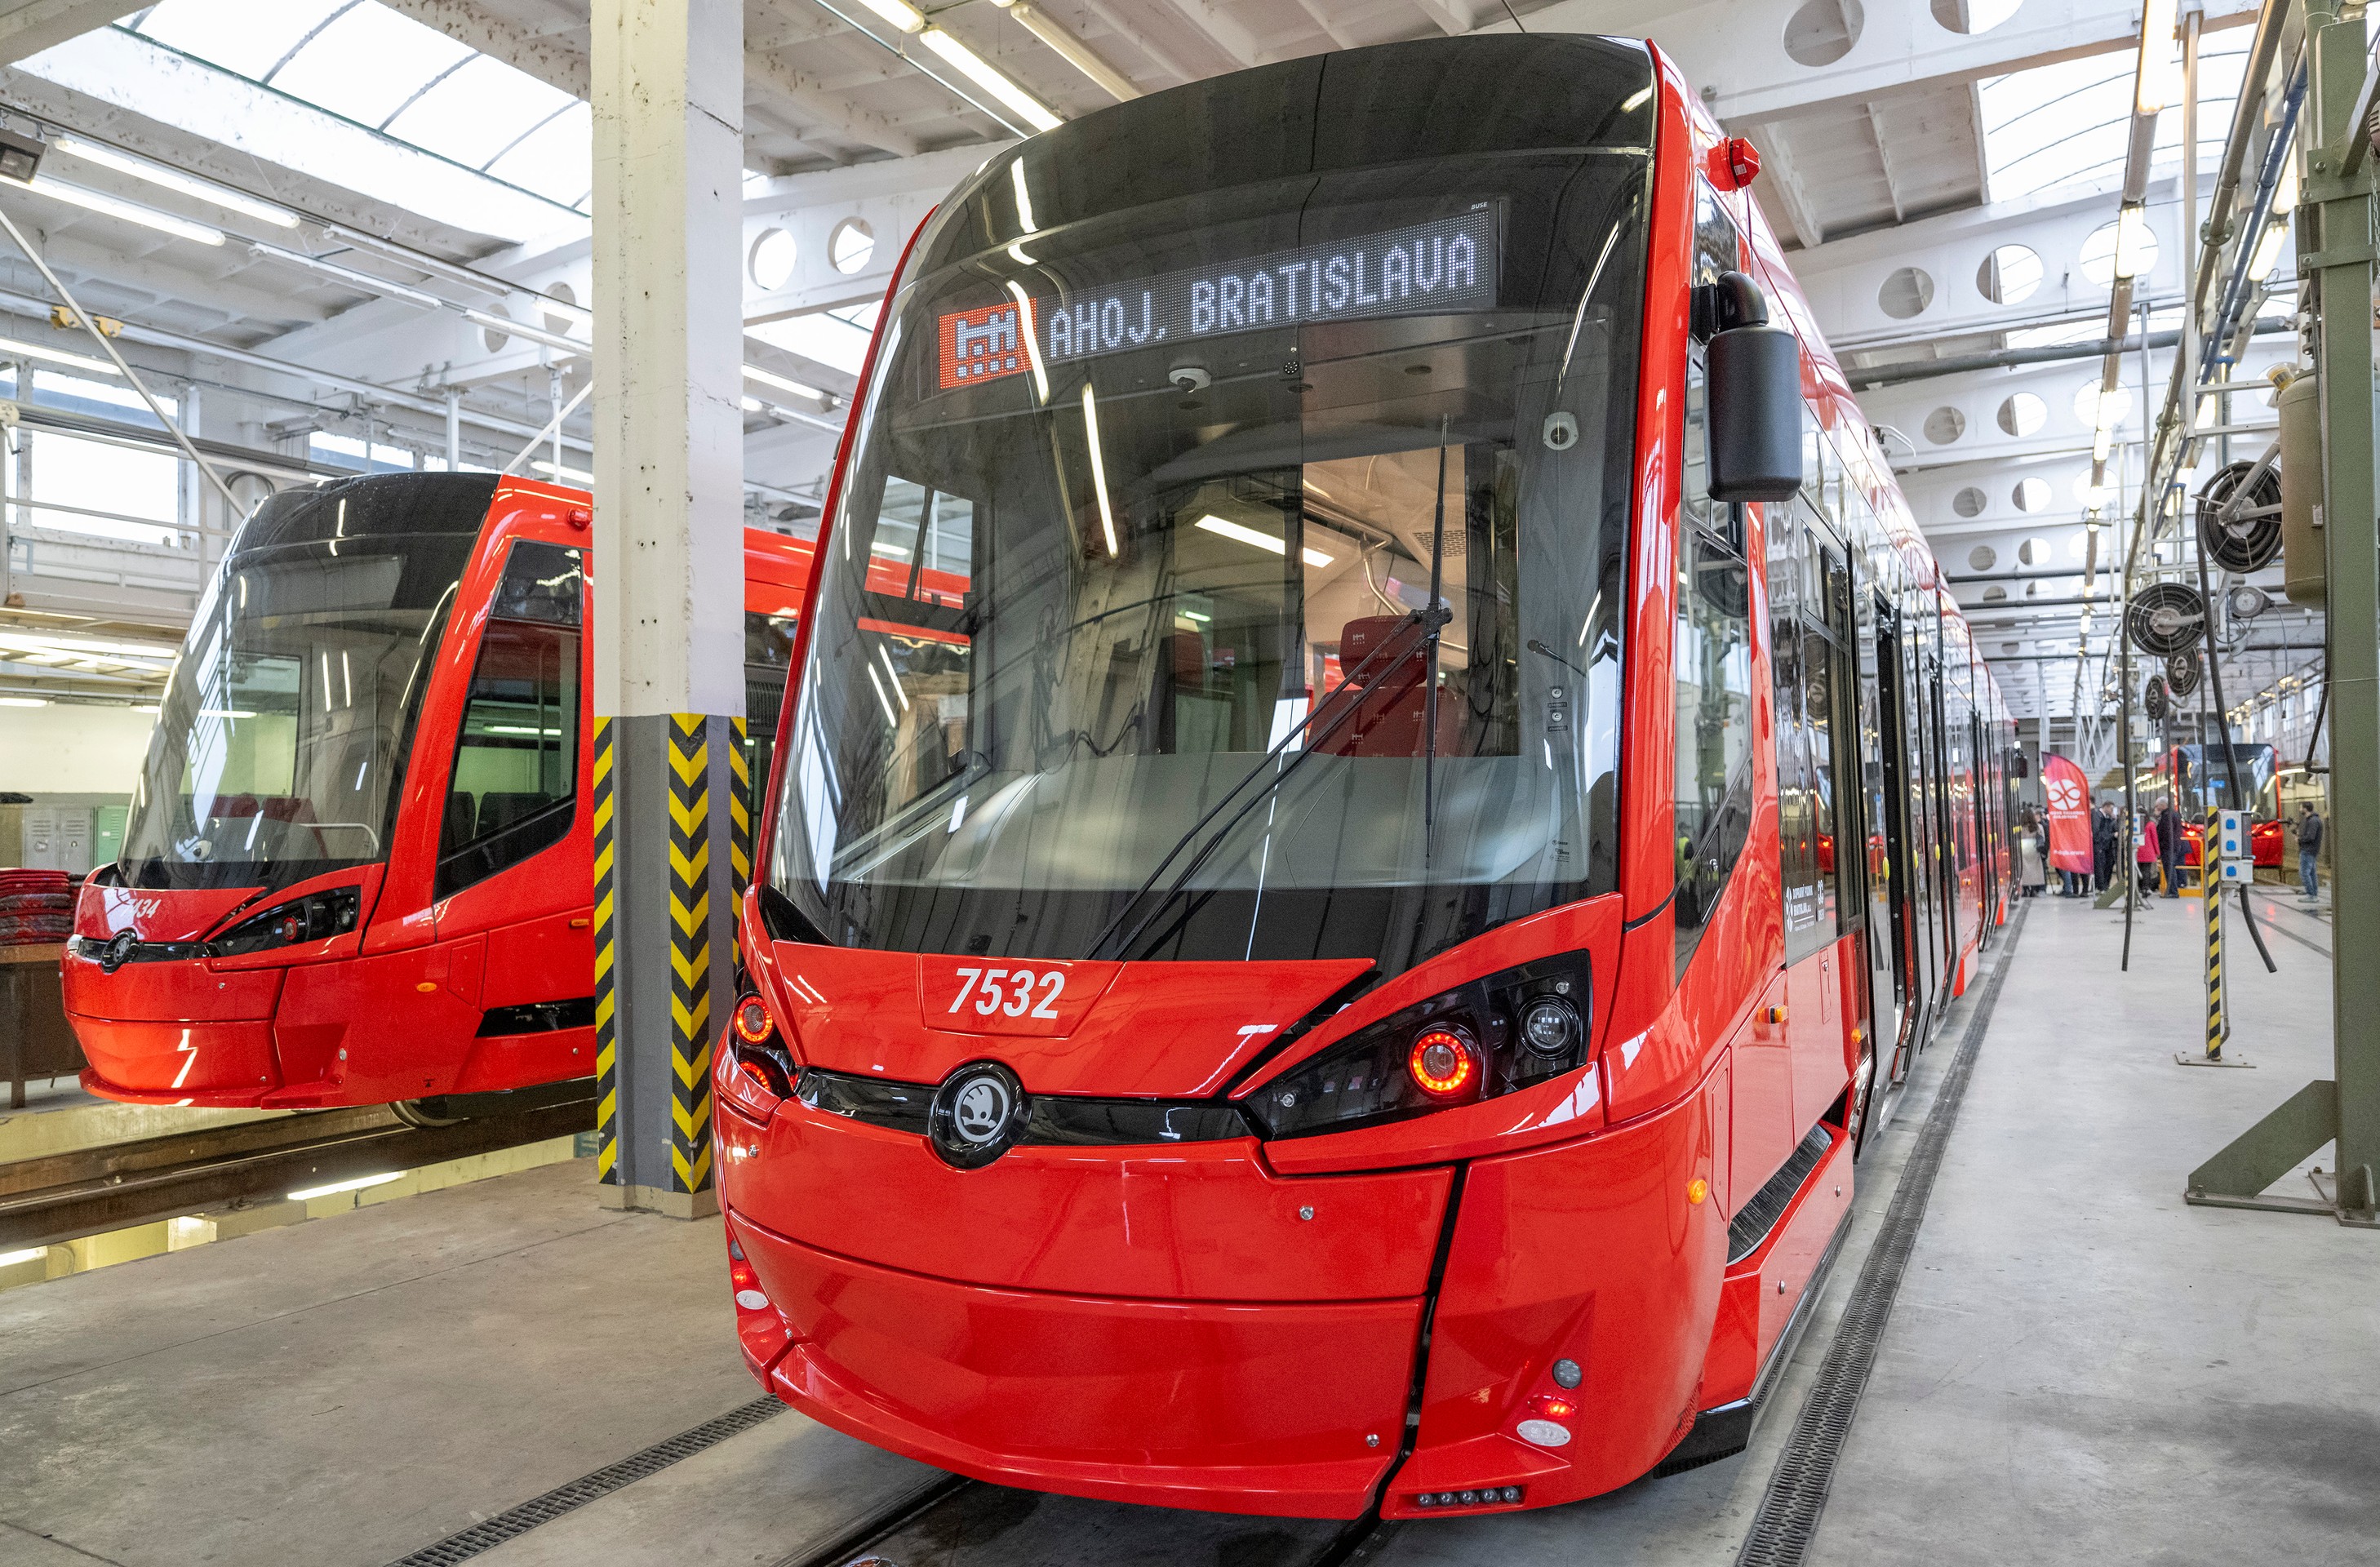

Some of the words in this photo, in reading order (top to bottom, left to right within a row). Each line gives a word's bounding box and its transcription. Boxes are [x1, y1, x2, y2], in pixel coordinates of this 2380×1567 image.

[1471, 201, 1488, 211] BUSE
[1050, 291, 1166, 357] AHOJ,
[1191, 233, 1475, 335] BRATISLAVA
[948, 967, 1066, 1019] 7532
